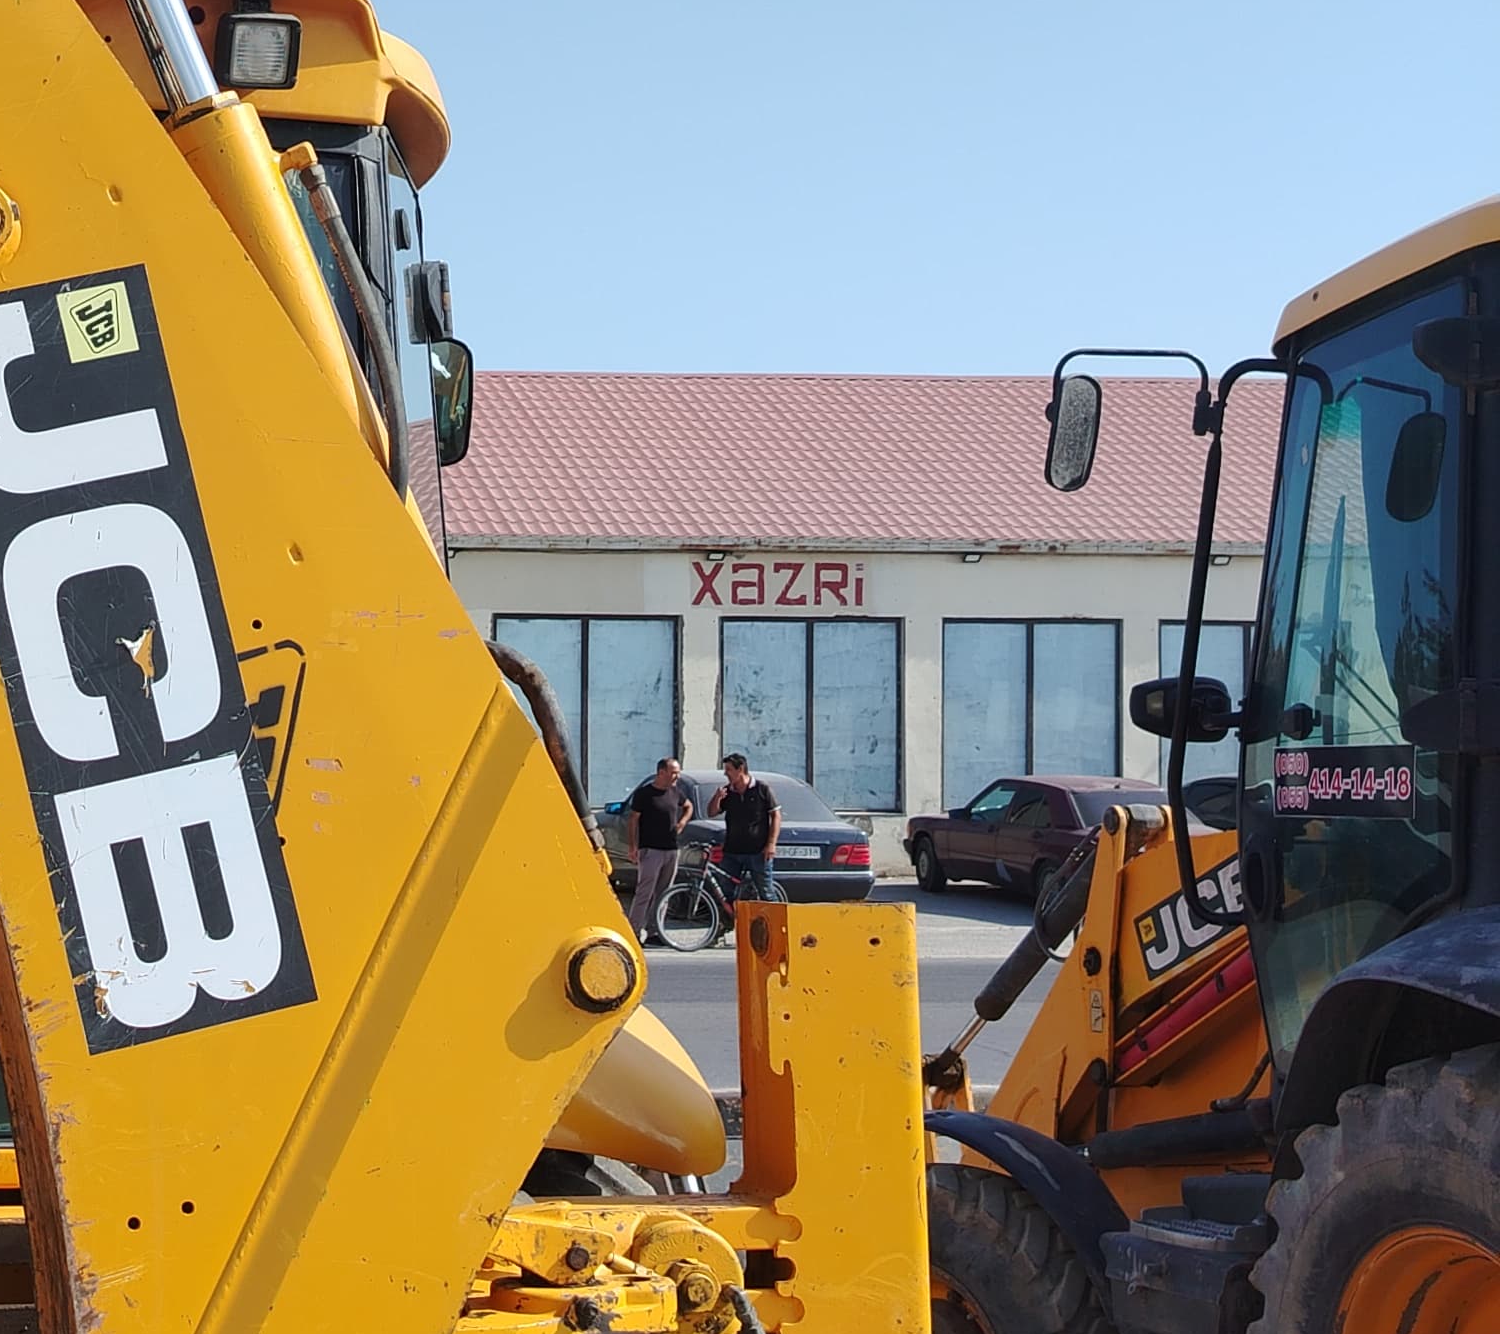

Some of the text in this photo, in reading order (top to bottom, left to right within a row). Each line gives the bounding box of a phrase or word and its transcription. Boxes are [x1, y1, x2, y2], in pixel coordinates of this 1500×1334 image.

[75, 298, 115, 348] JCB
[1275, 751, 1310, 778] (050)
[1308, 766, 1411, 801] 414-14-18
